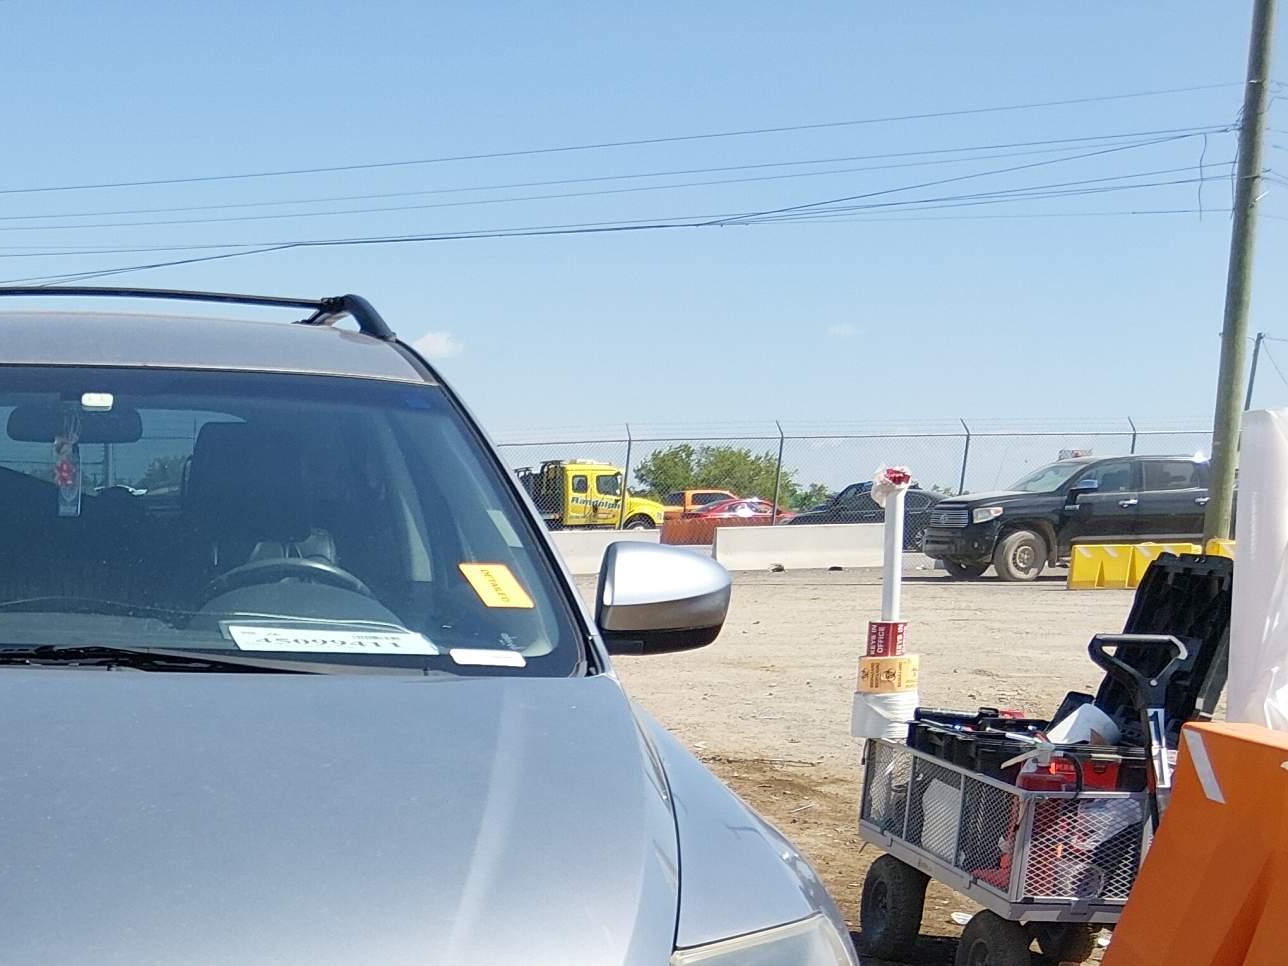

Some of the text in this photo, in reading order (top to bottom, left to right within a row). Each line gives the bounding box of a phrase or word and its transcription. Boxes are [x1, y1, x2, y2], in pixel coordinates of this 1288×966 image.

[871, 624, 878, 632] IN
[869, 635, 877, 655] KEYS
[876, 626, 885, 654] OFFICE
